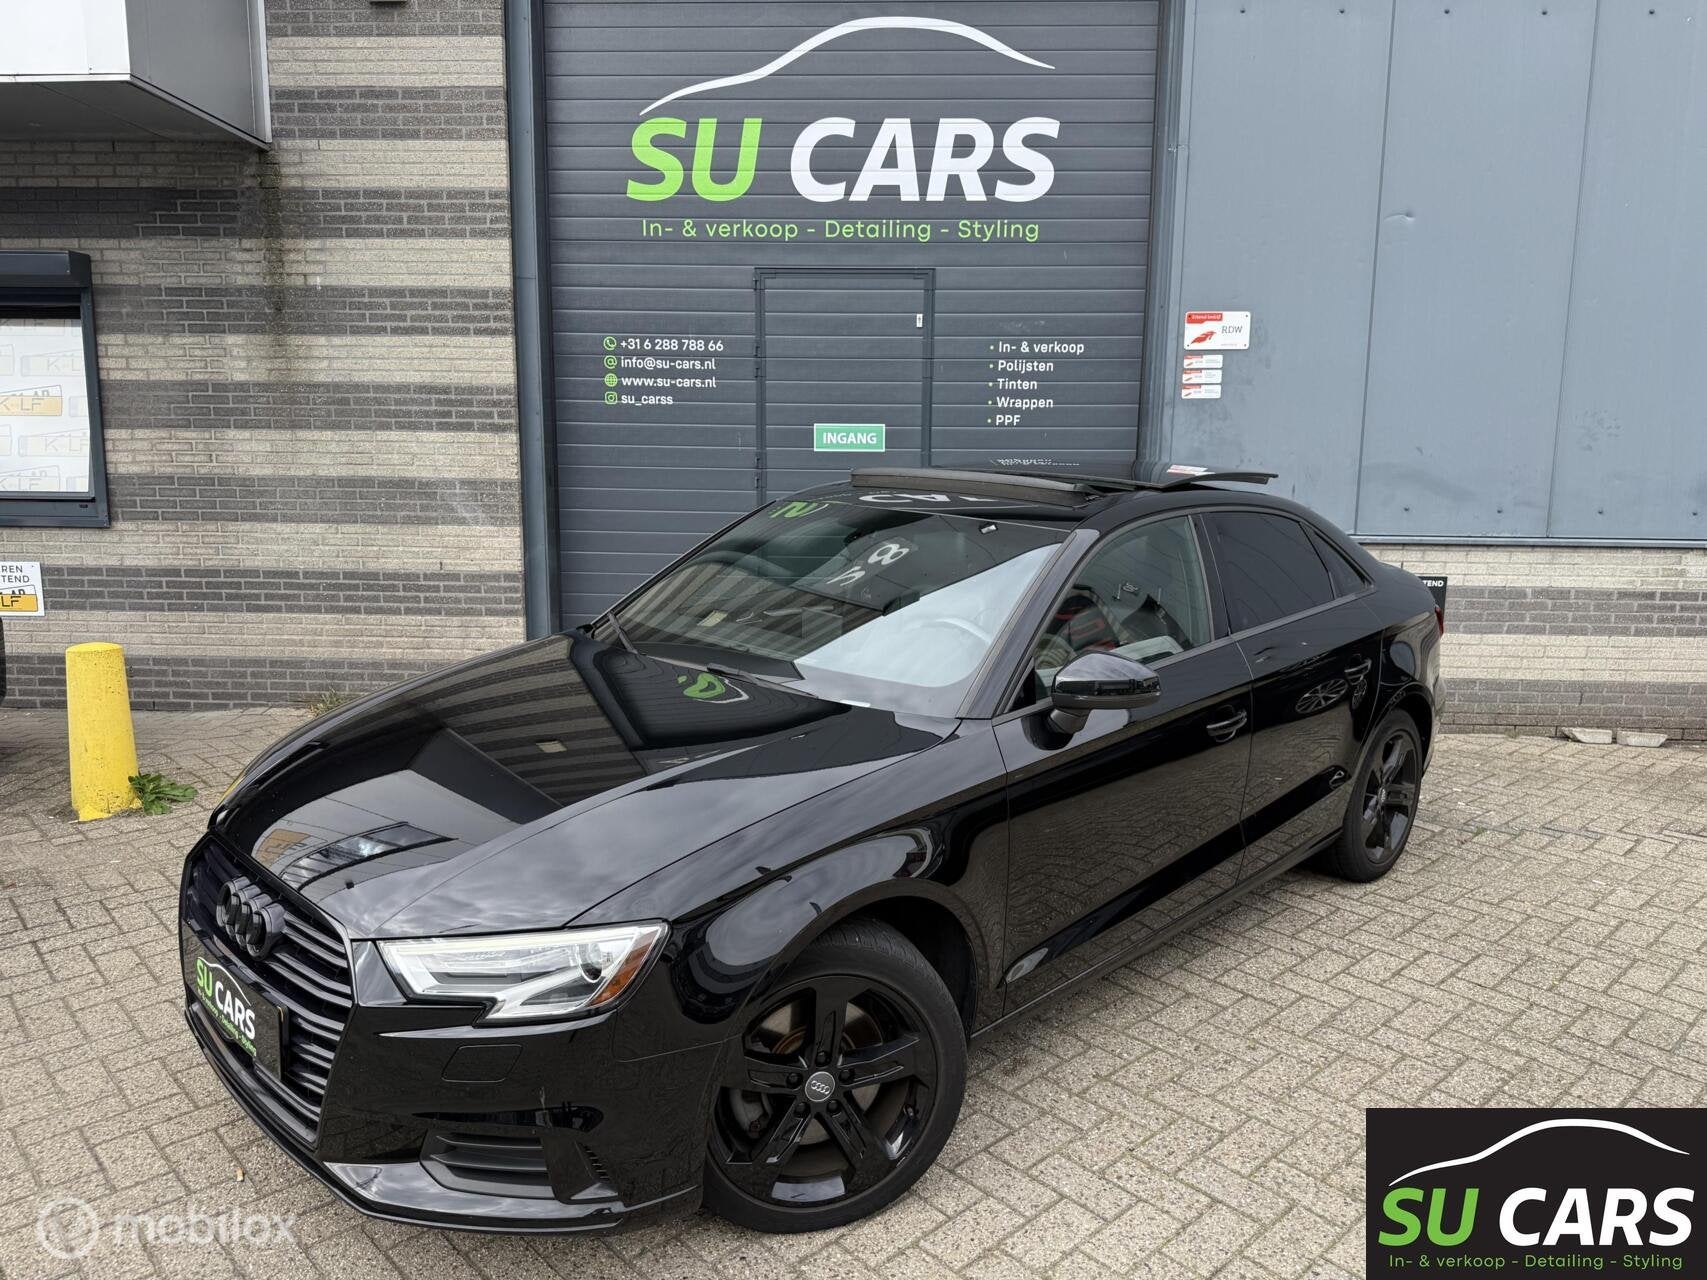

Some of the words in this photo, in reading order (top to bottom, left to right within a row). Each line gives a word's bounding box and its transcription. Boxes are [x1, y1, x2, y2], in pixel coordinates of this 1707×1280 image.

[626, 116, 763, 202] SU
[790, 116, 1060, 203] CARS
[642, 220, 673, 237] In-
[682, 219, 697, 238] &
[706, 220, 798, 241] verkoop
[825, 220, 931, 242] Detailing
[958, 220, 1040, 242] Styling
[1221, 325, 1243, 334] RDW
[620, 338, 641, 350] +31
[643, 338, 651, 350] 6
[654, 339, 679, 351] 288
[682, 339, 705, 351] 788
[708, 340, 724, 352] 66
[998, 341, 1017, 353] In-
[1020, 341, 1030, 353] &
[1033, 341, 1085, 355] verkoop
[621, 356, 717, 370] info@su-cars.nl
[998, 360, 1054, 374] Polijsten
[621, 376, 717, 388] www.su-cars.nl
[997, 378, 1038, 390] Tinten
[621, 393, 674, 406] su_carss
[996, 396, 1054, 410] Wrappen
[995, 415, 1021, 426] PPF
[823, 432, 877, 444] INGANG
[1, 575, 30, 583] TEND
[196, 959, 213, 997] SU
[215, 981, 256, 1040] CARS
